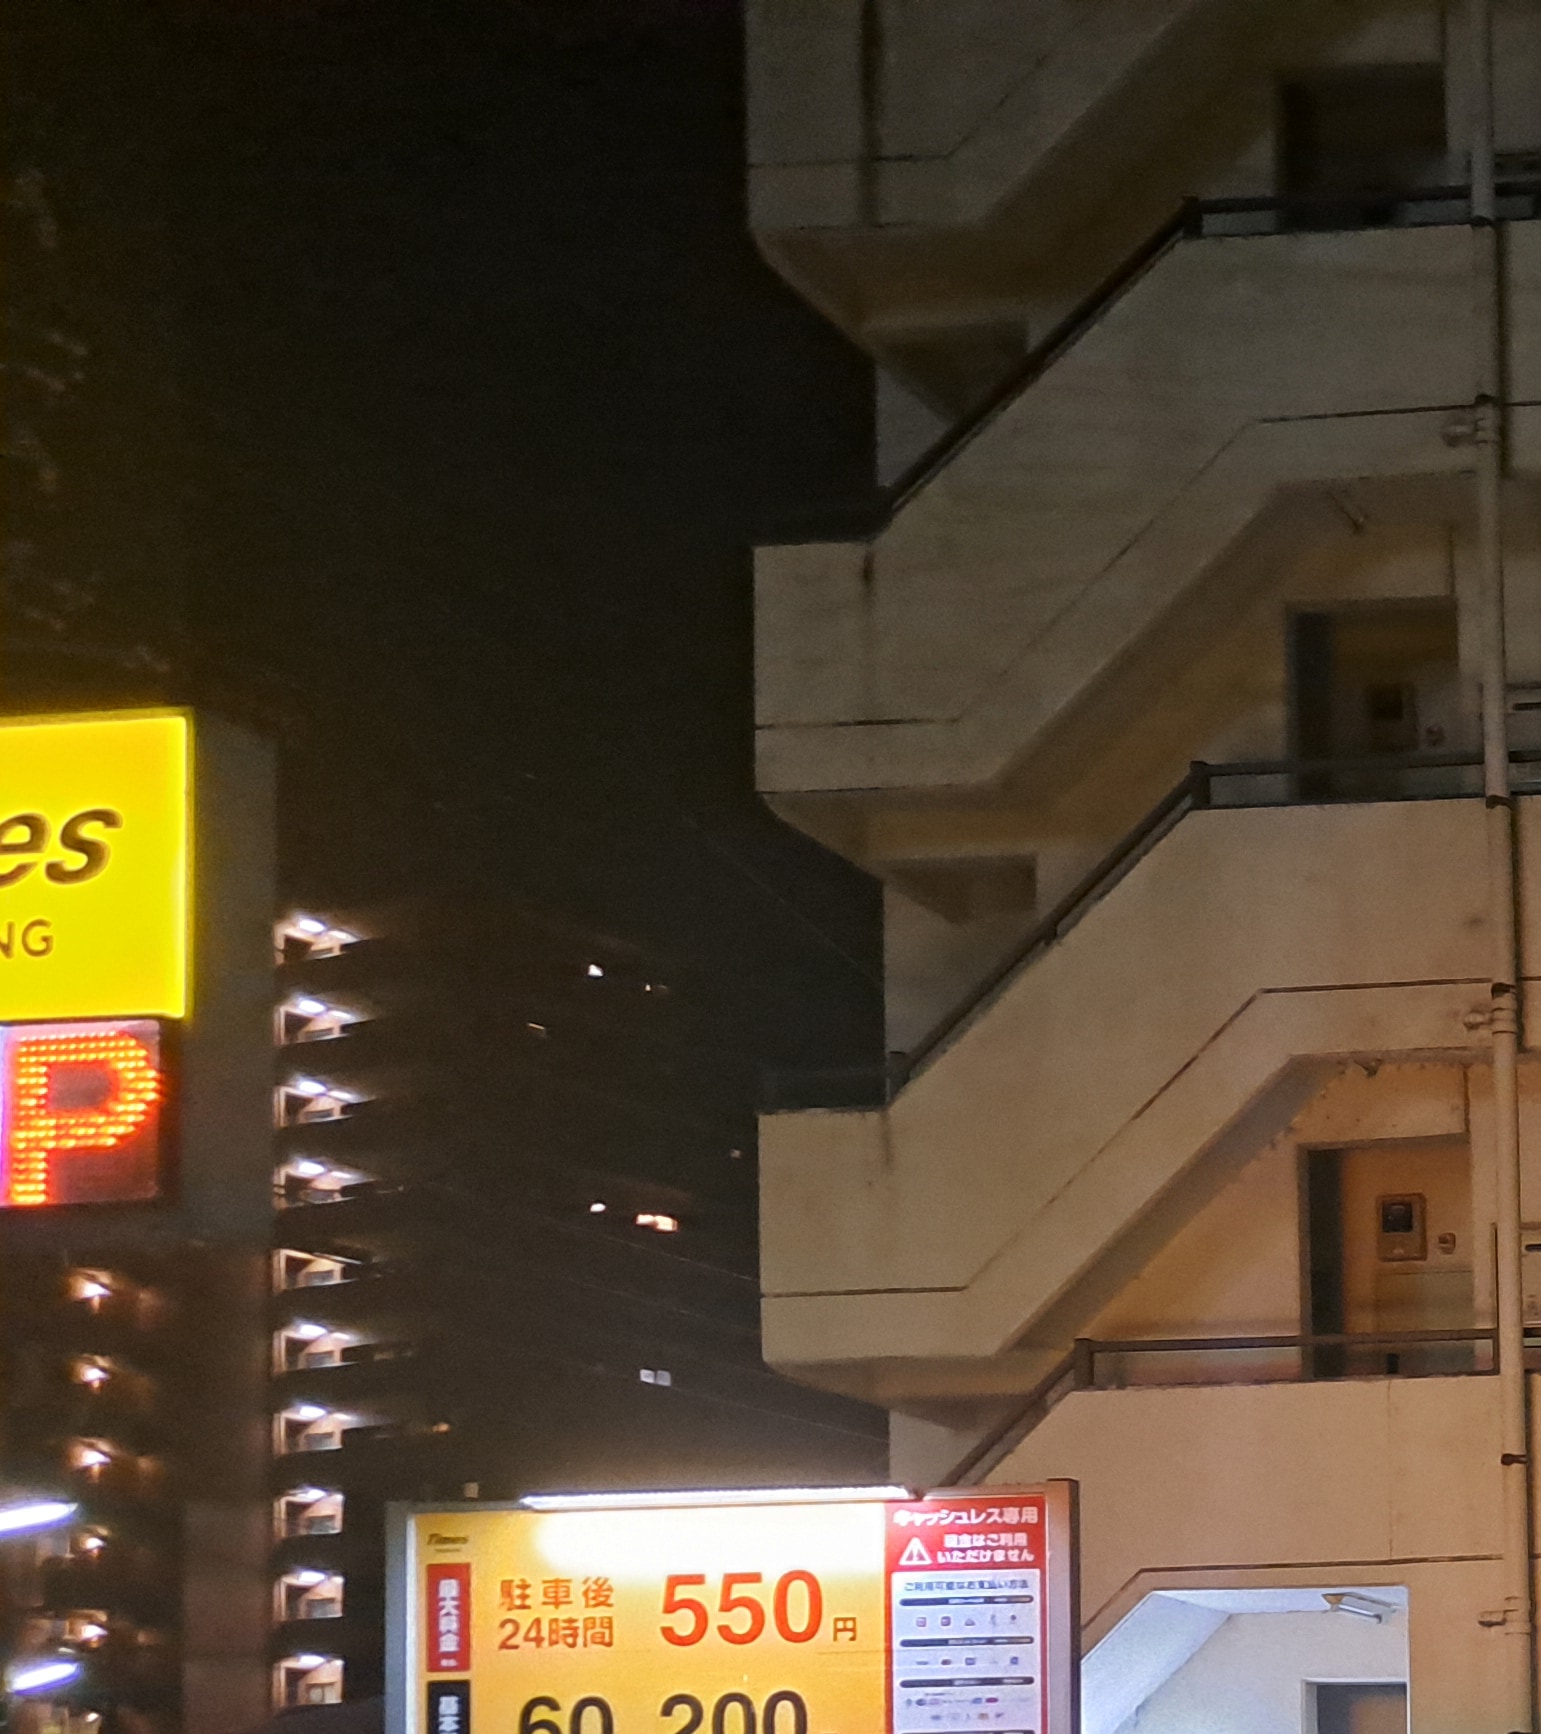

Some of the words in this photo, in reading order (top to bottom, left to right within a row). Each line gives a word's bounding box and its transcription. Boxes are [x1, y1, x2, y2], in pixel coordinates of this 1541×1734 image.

[499, 1577, 614, 1611] 駐車後
[499, 1616, 614, 1651] 24時間
